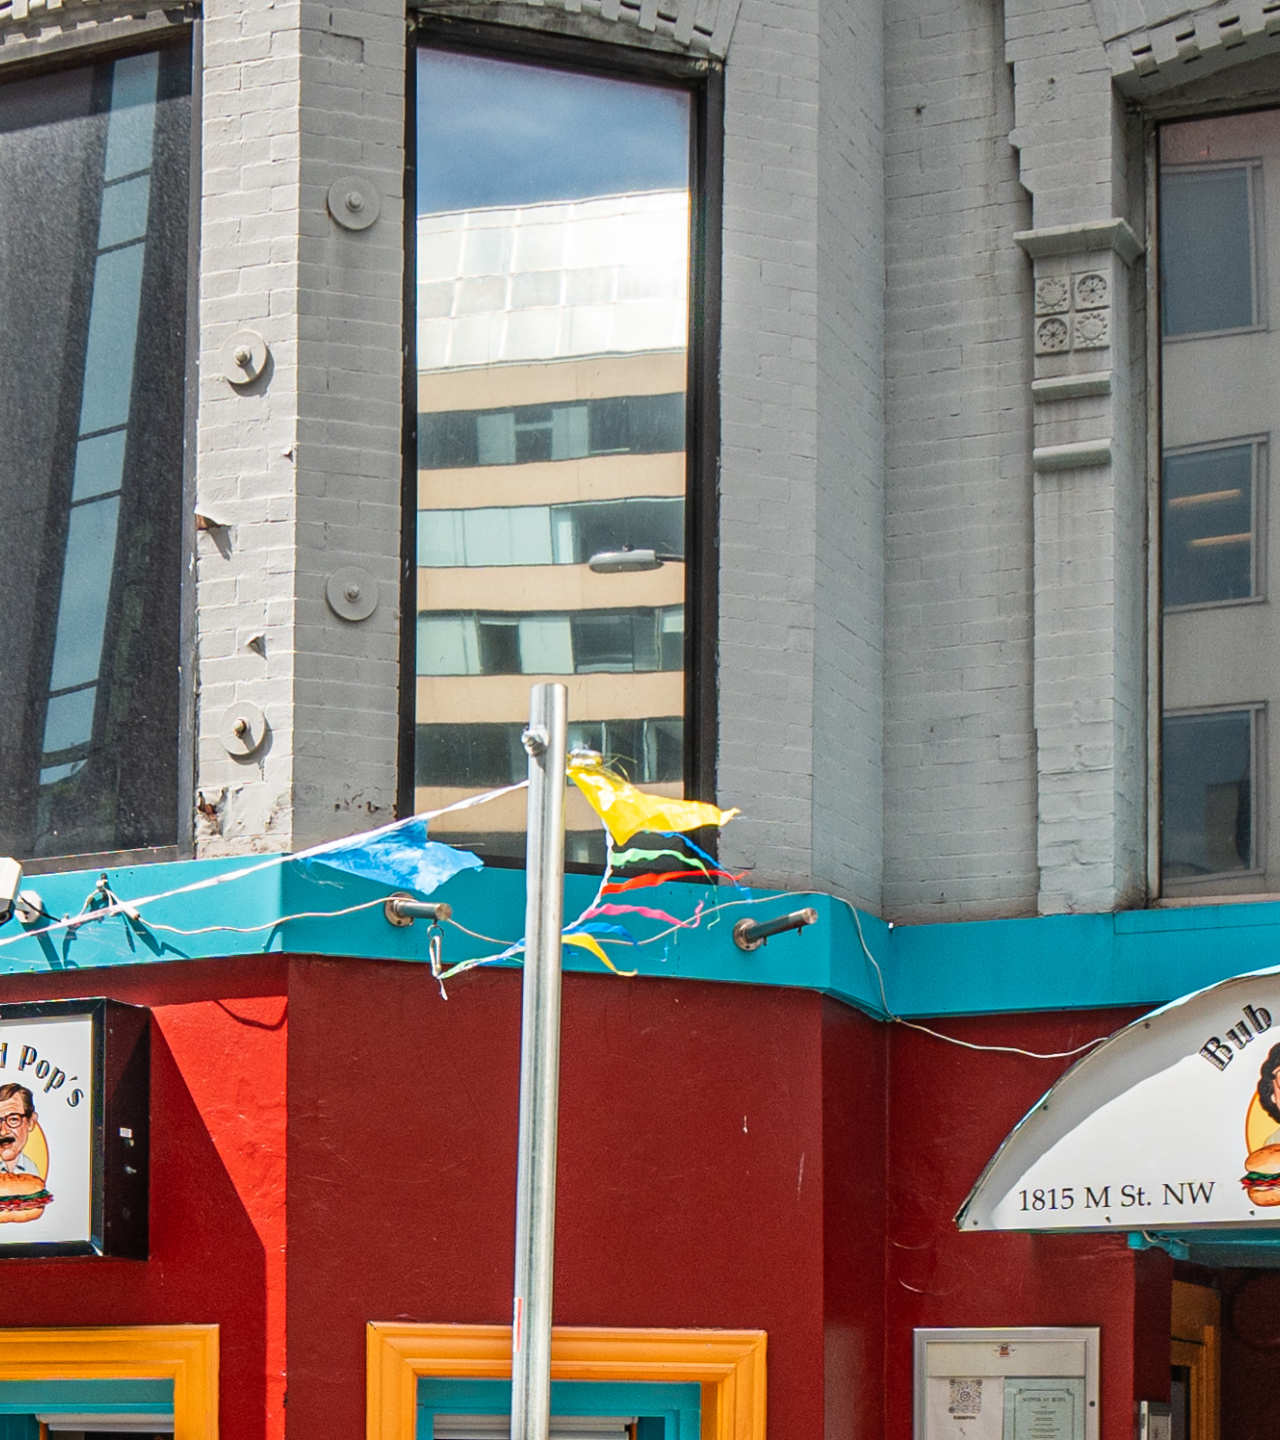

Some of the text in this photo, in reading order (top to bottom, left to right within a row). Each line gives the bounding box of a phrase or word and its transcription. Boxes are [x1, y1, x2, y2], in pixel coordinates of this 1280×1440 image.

[1199, 1004, 1273, 1071] Bub
[18, 1044, 84, 1108] Pop's
[1019, 1181, 1216, 1211] 1815 M St. NW
